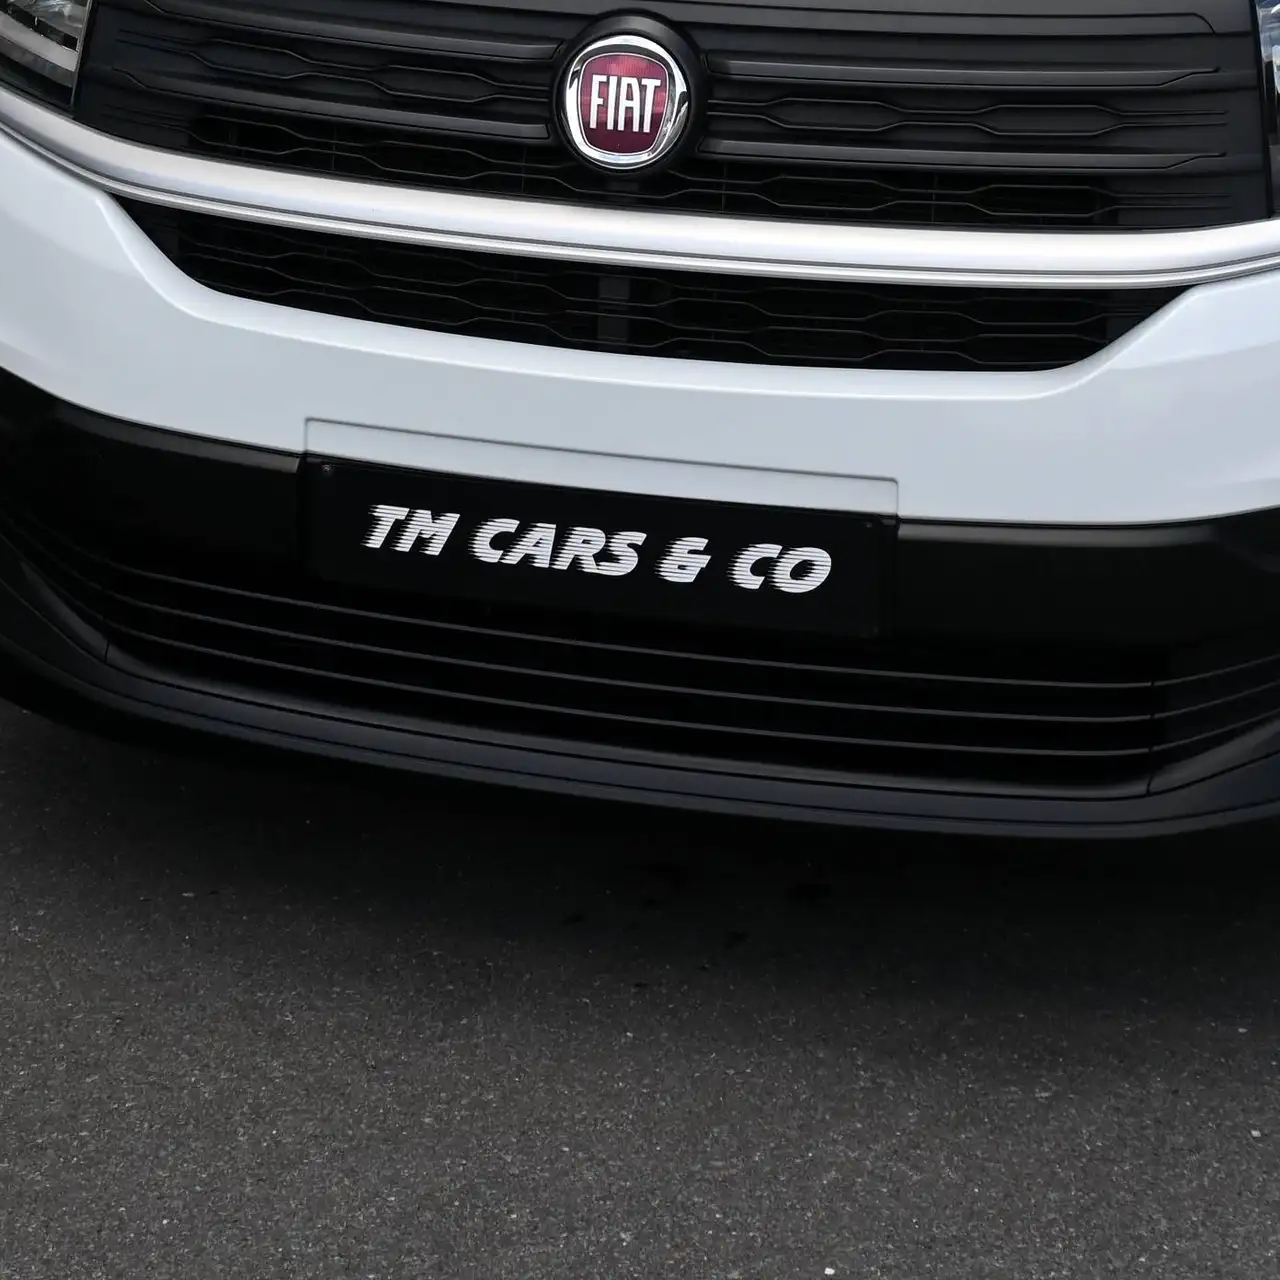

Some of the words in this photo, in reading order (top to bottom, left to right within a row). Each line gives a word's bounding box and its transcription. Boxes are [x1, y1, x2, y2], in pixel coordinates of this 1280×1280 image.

[589, 74, 661, 133] FIAT
[361, 504, 461, 556] TM
[467, 518, 648, 577] CARS
[655, 536, 712, 583] &
[726, 543, 832, 594] CO
